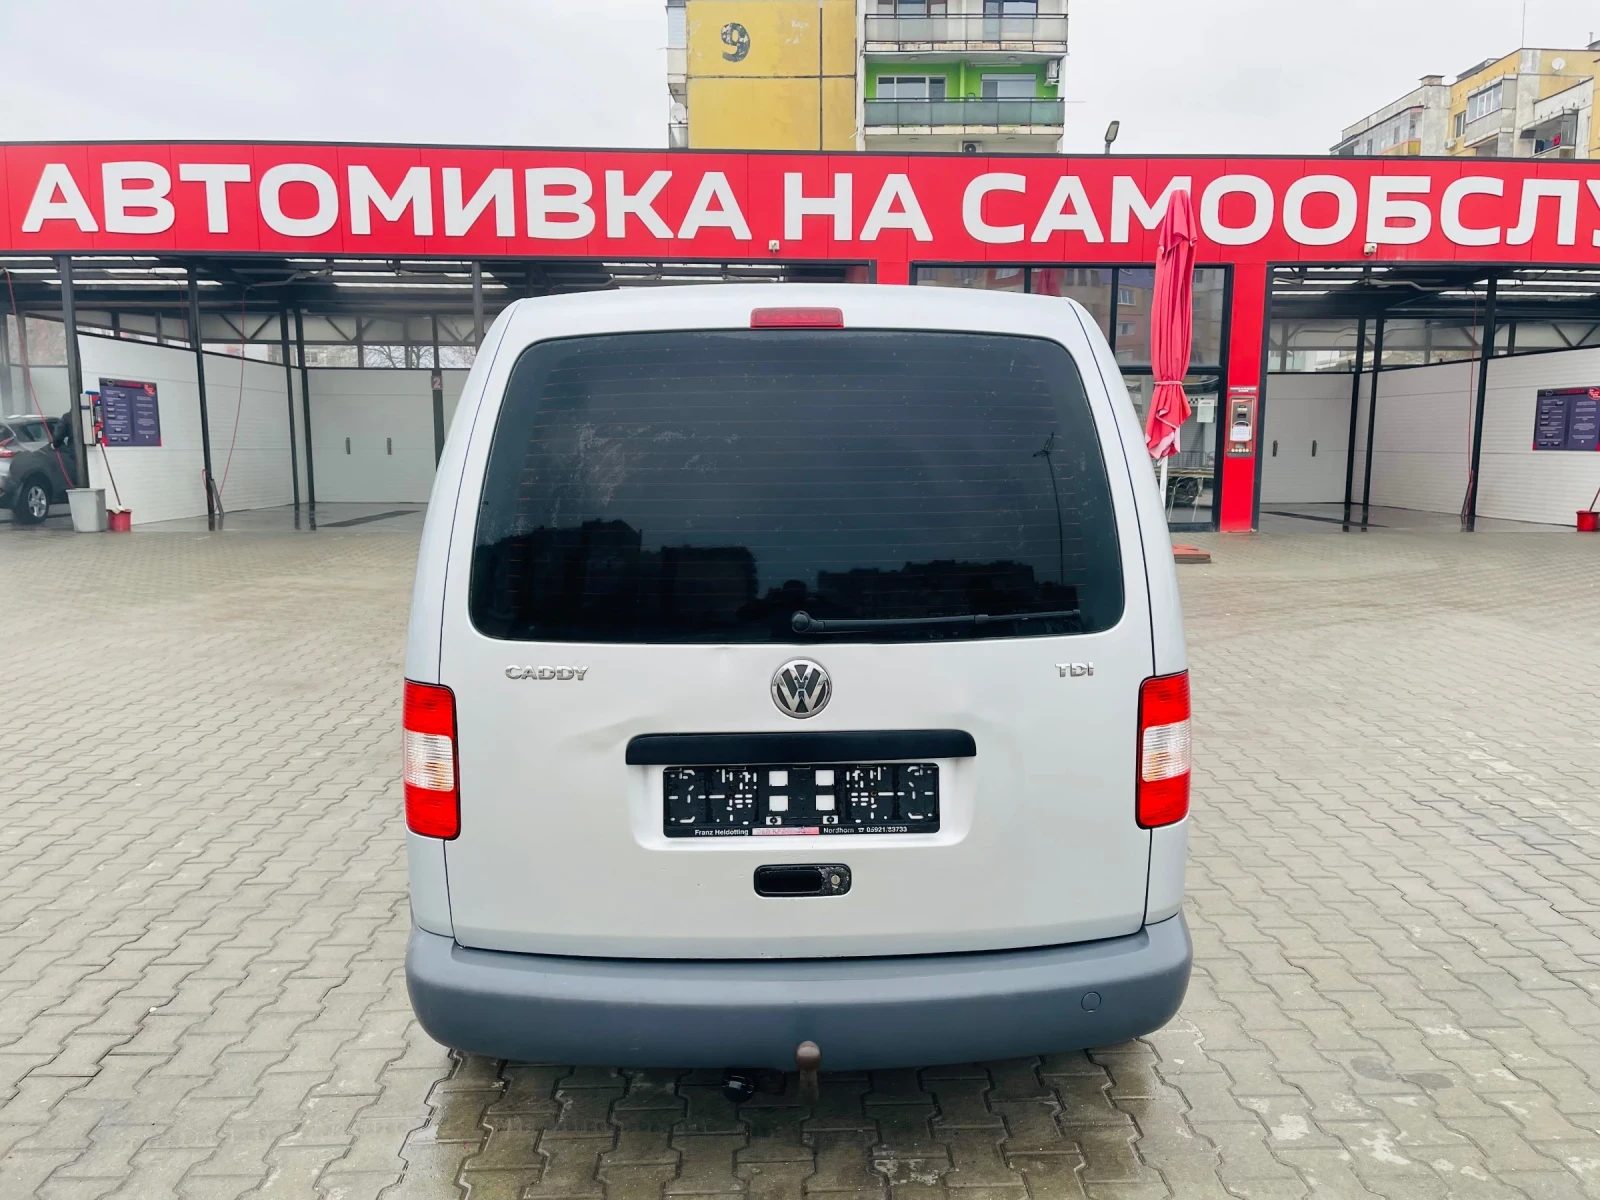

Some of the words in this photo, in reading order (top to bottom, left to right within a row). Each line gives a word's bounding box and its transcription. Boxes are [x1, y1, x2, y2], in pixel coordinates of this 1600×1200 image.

[721, 22, 750, 62] 9
[22, 161, 752, 241] АВТОМИВКА
[784, 172, 934, 242] НА
[961, 172, 1600, 247] САМООБСЛ
[433, 377, 441, 389] 2
[505, 664, 589, 681] CADDY
[1055, 661, 1094, 678] TDI
